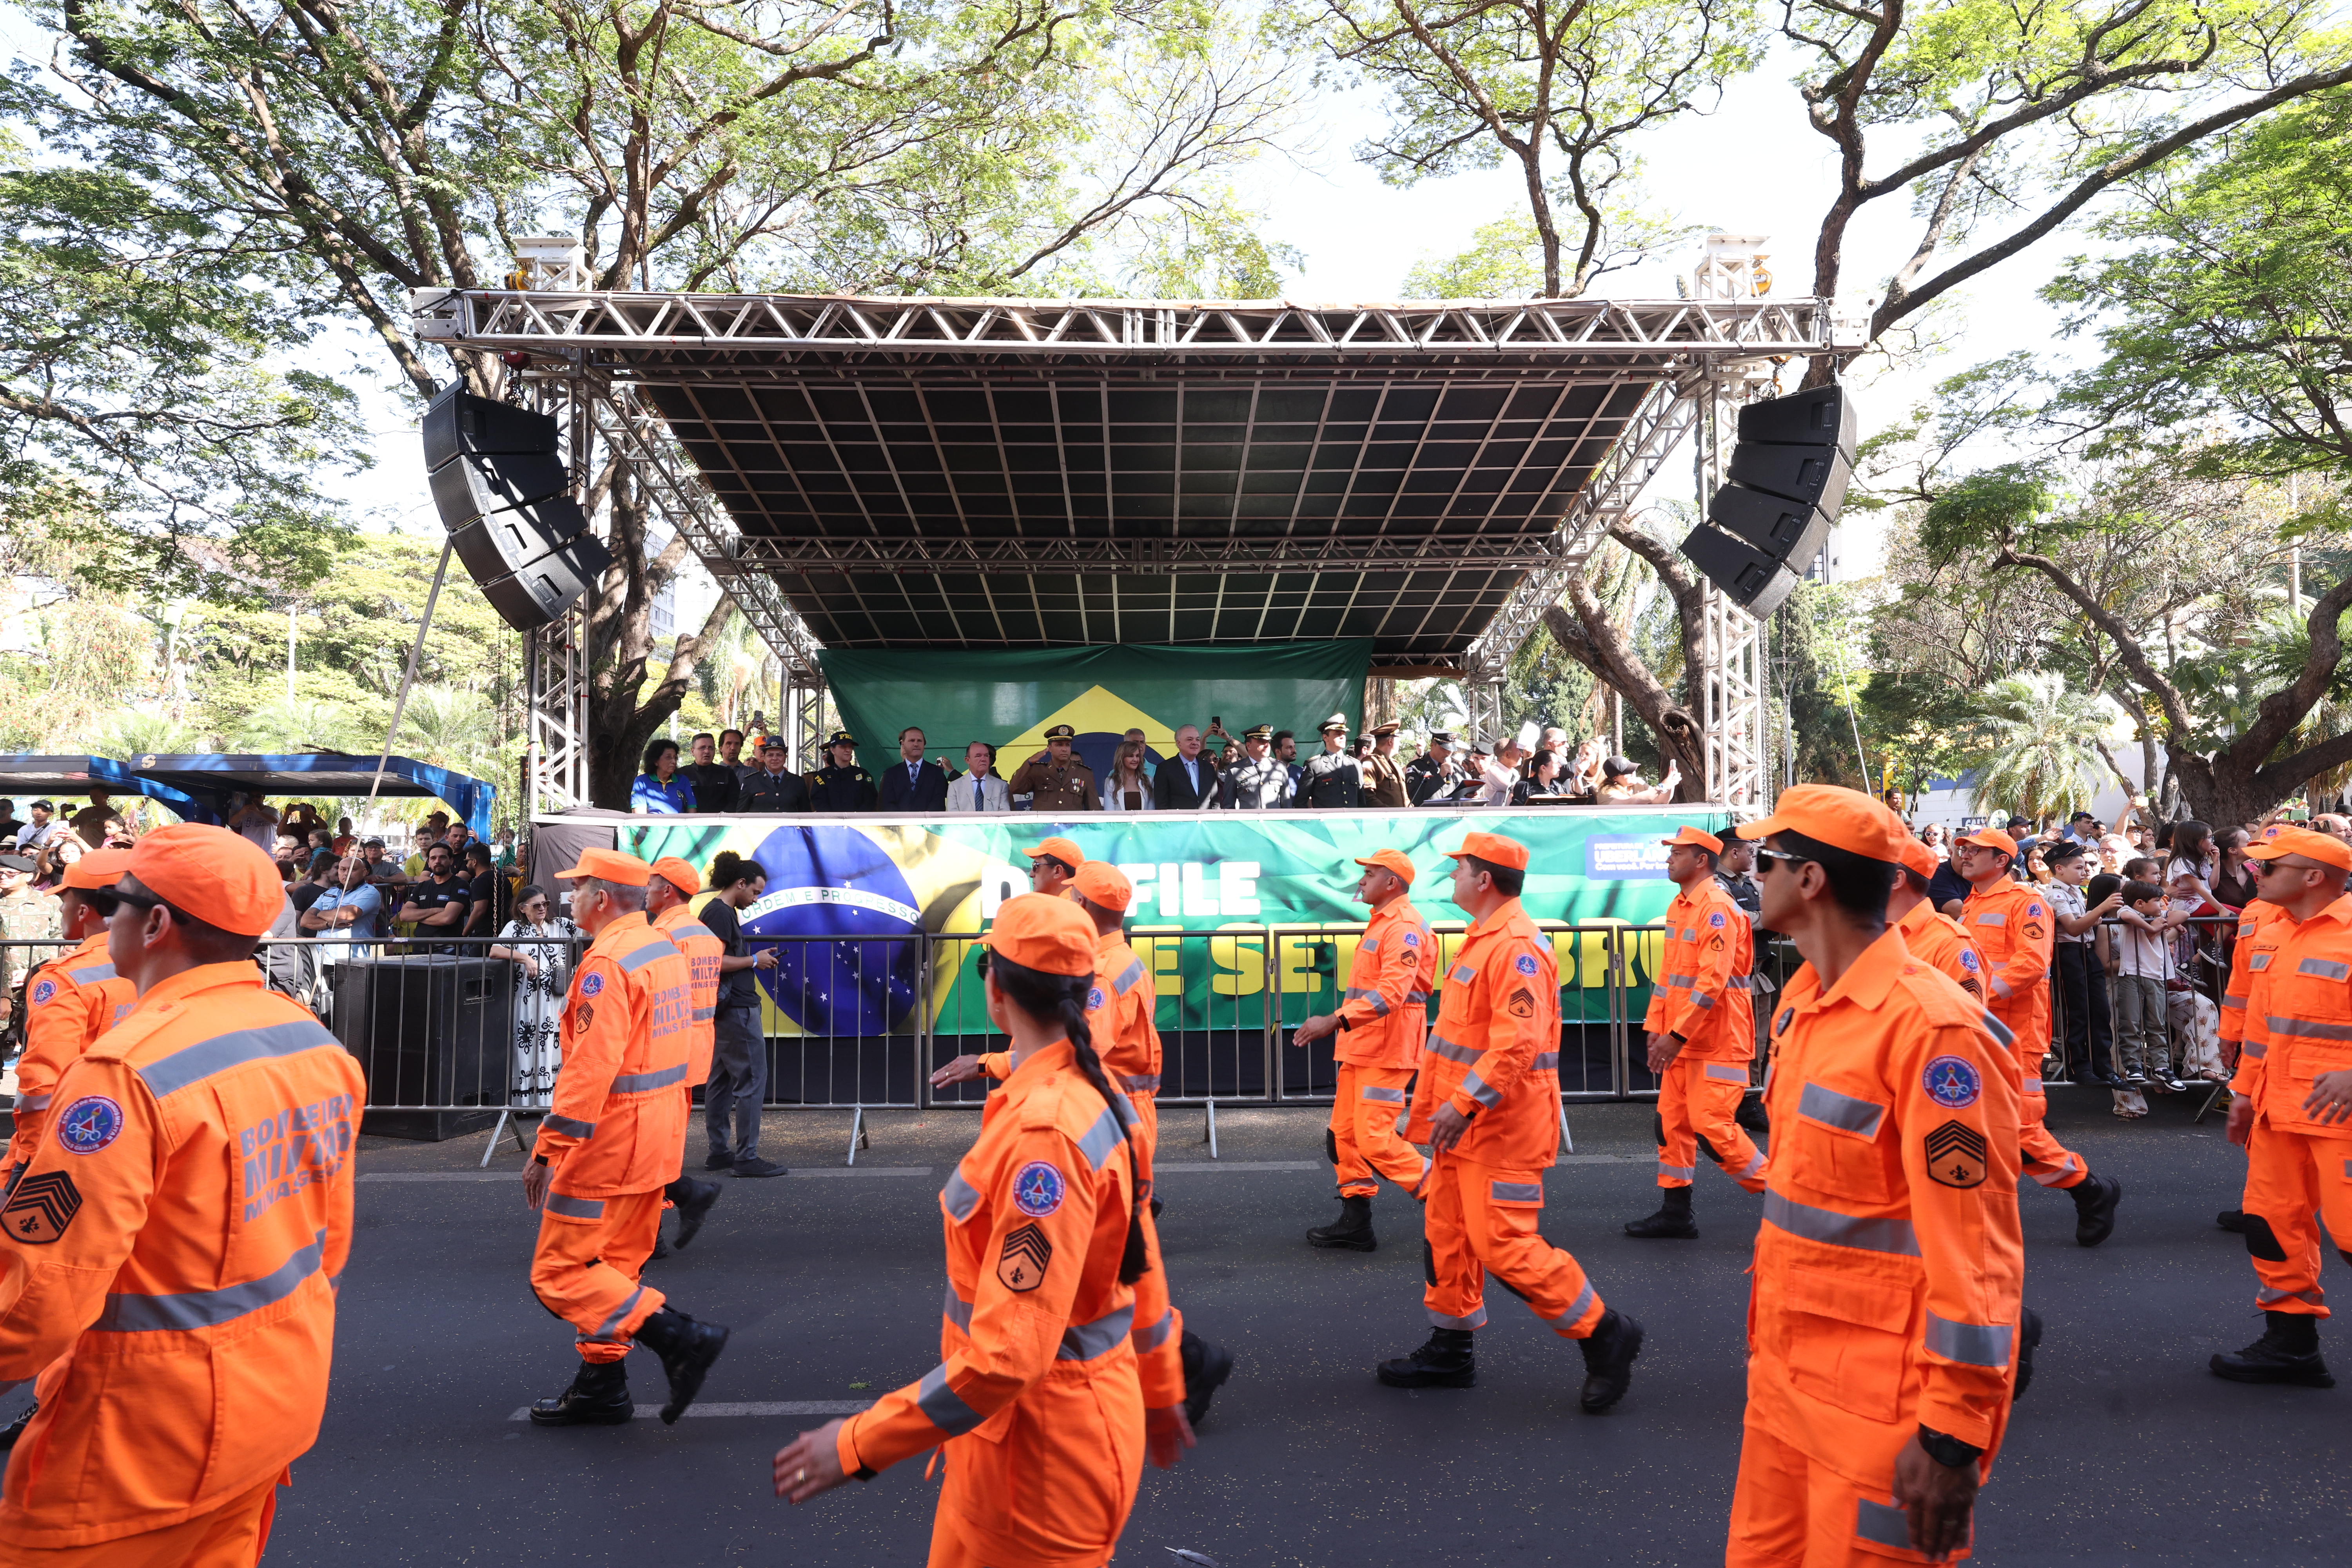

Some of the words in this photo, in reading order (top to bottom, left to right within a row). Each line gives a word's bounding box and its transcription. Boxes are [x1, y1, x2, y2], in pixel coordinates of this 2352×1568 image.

[815, 775, 825, 785] PRF
[1965, 819, 1987, 828] CAIX
[1595, 862, 1616, 871] Com
[1640, 862, 1655, 870] Por
[981, 862, 1261, 919] DFILE
[742, 892, 795, 919] ORDEM
[806, 891, 813, 901] E
[821, 889, 920, 923] PROGRESSO
